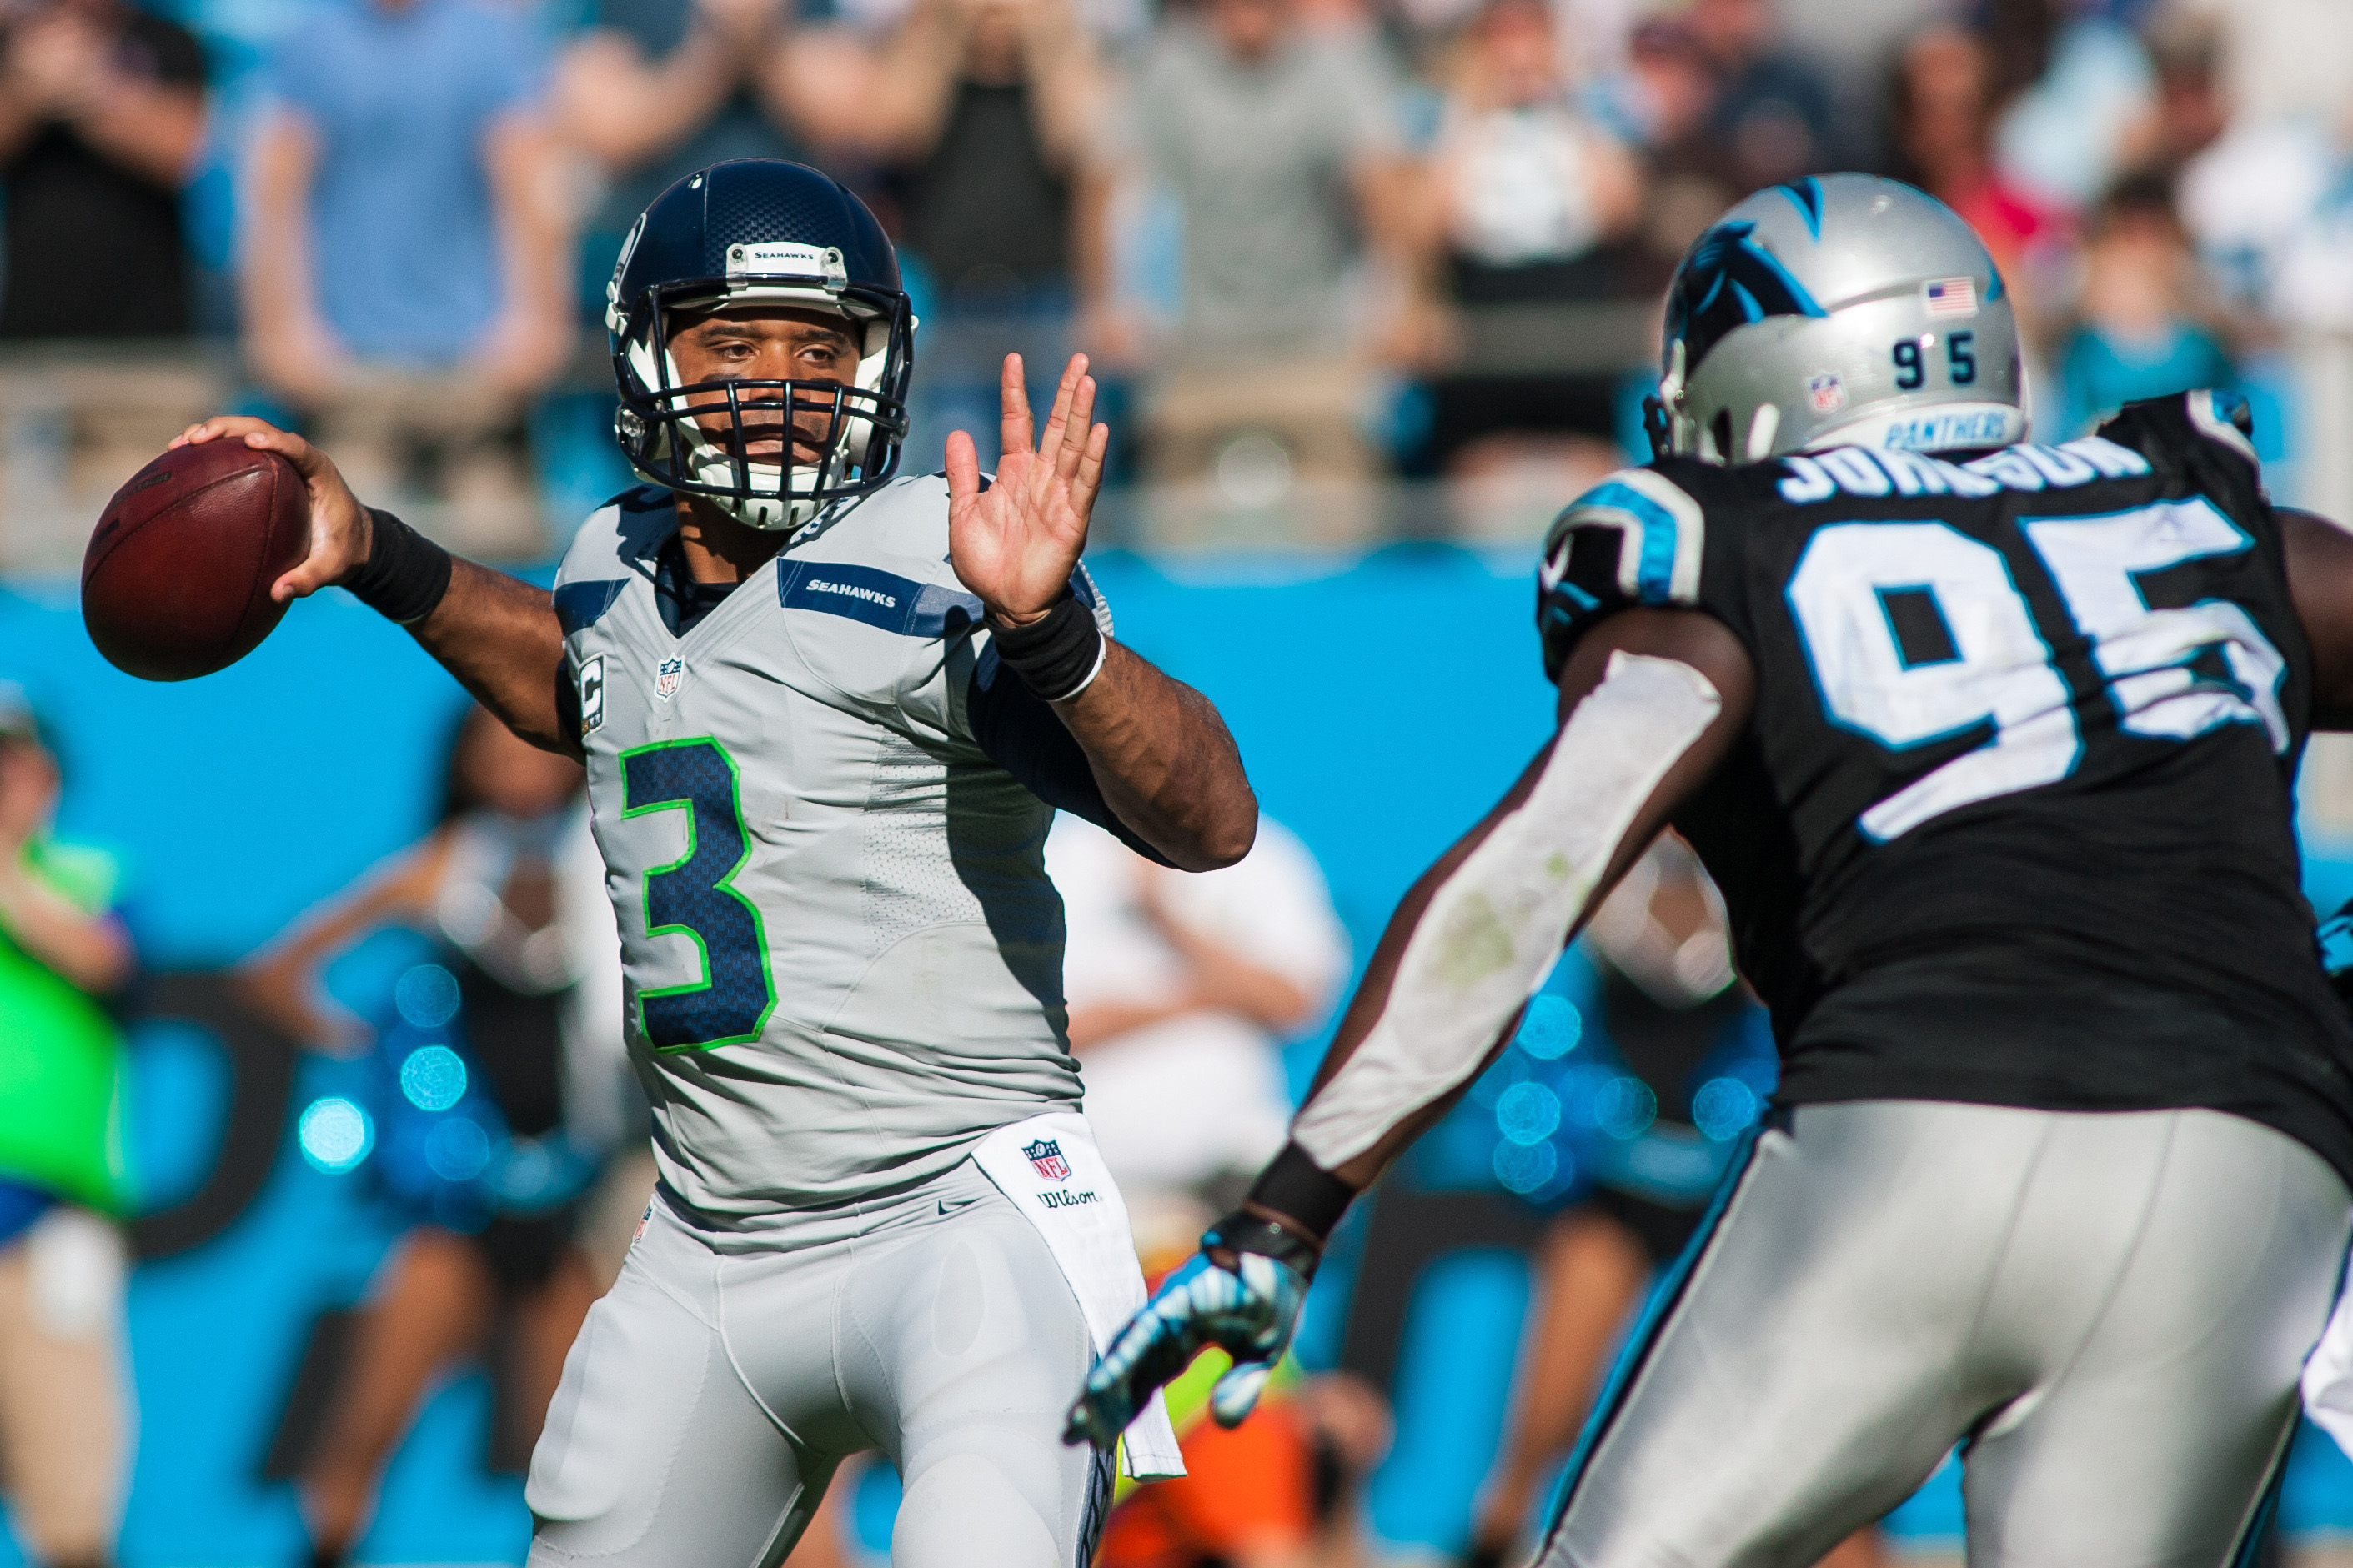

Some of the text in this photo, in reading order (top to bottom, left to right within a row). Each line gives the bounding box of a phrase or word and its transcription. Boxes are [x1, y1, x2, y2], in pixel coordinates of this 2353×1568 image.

[755, 252, 814, 260] SEAHAWKS
[805, 579, 896, 608] SEAHAWKS
[1784, 495, 2292, 847] 95
[581, 659, 601, 719] C
[659, 674, 677, 694] NFL
[619, 734, 780, 1055] 3
[1034, 1157, 1068, 1179] NFL
[1036, 1189, 1100, 1209] Wilson
